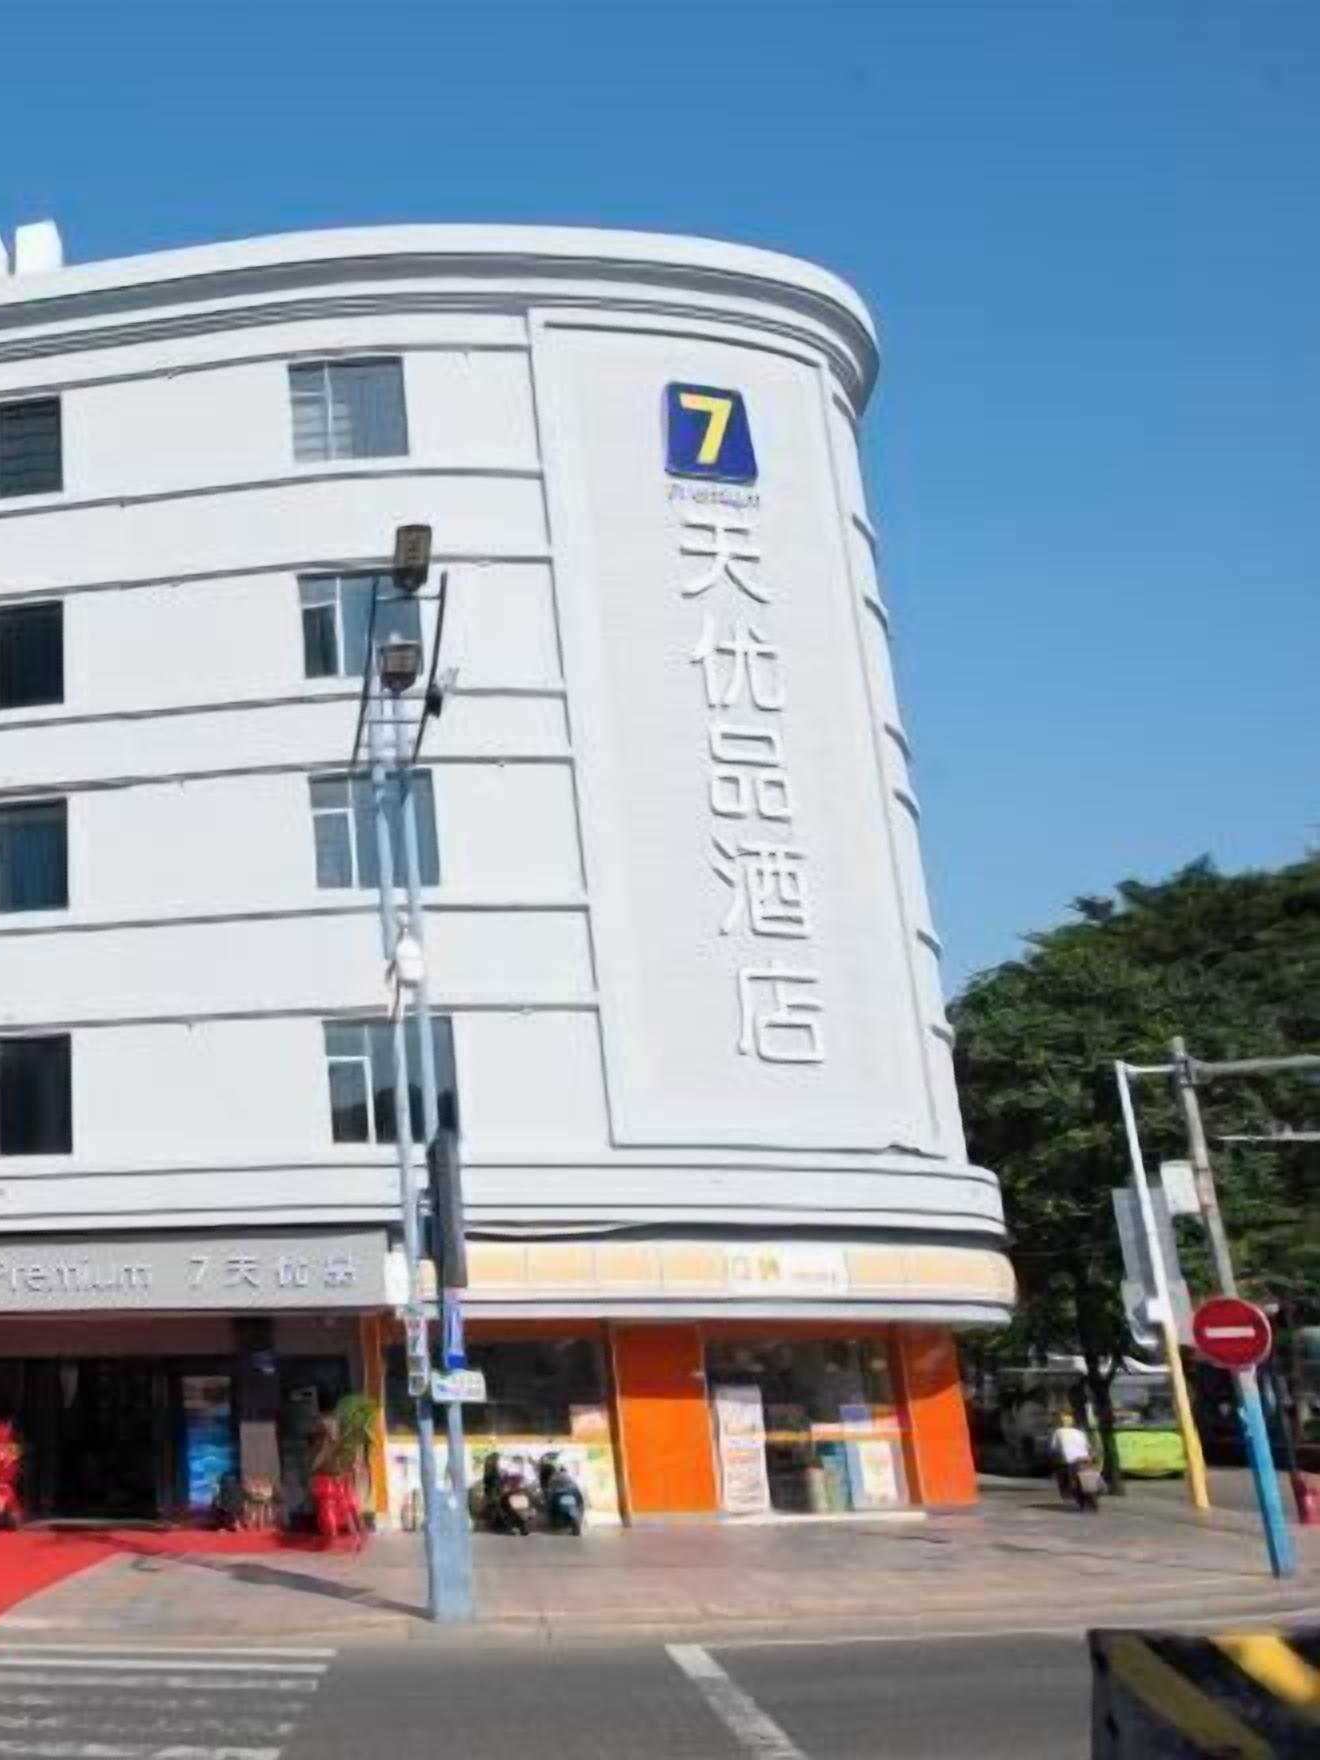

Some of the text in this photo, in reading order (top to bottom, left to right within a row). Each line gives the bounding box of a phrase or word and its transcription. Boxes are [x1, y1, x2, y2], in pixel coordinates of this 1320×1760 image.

[679, 391, 733, 464] 7
[680, 516, 825, 1066] 天优品酒店
